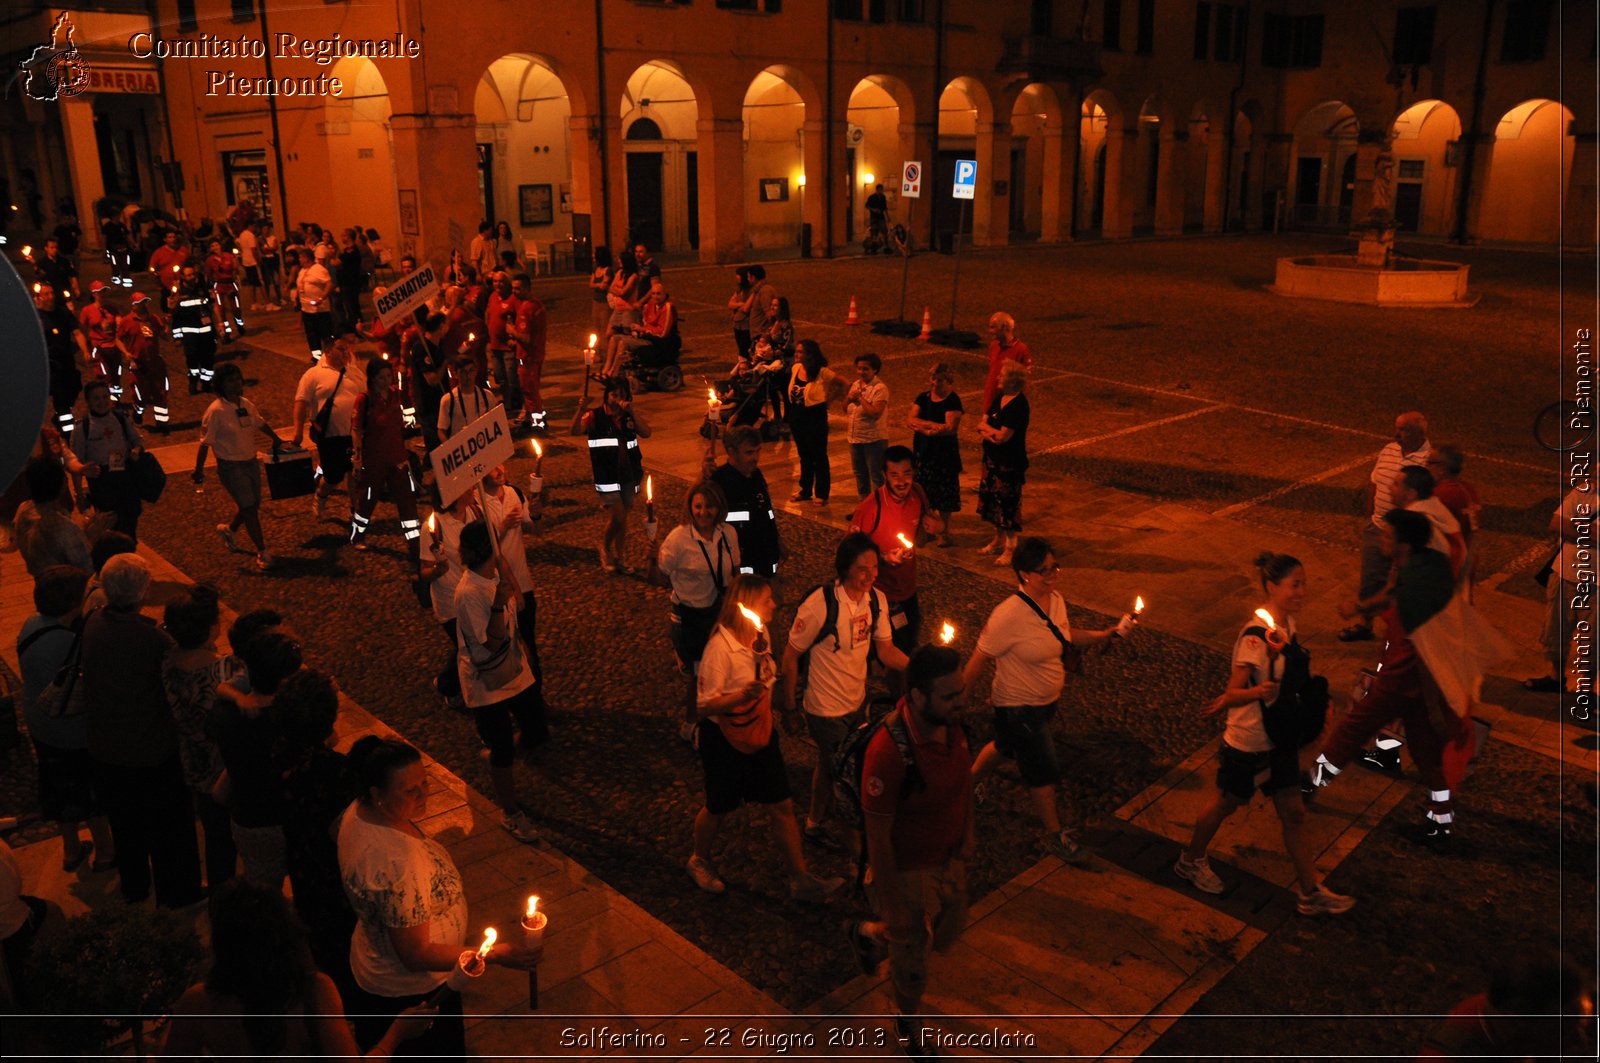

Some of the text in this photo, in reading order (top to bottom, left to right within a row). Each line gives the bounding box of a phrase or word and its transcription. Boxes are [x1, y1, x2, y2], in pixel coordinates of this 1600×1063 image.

[90, 71, 157, 92] BRERIA
[958, 162, 974, 184] P
[376, 267, 434, 315] CESENATICO
[441, 420, 503, 477] MELDOLA
